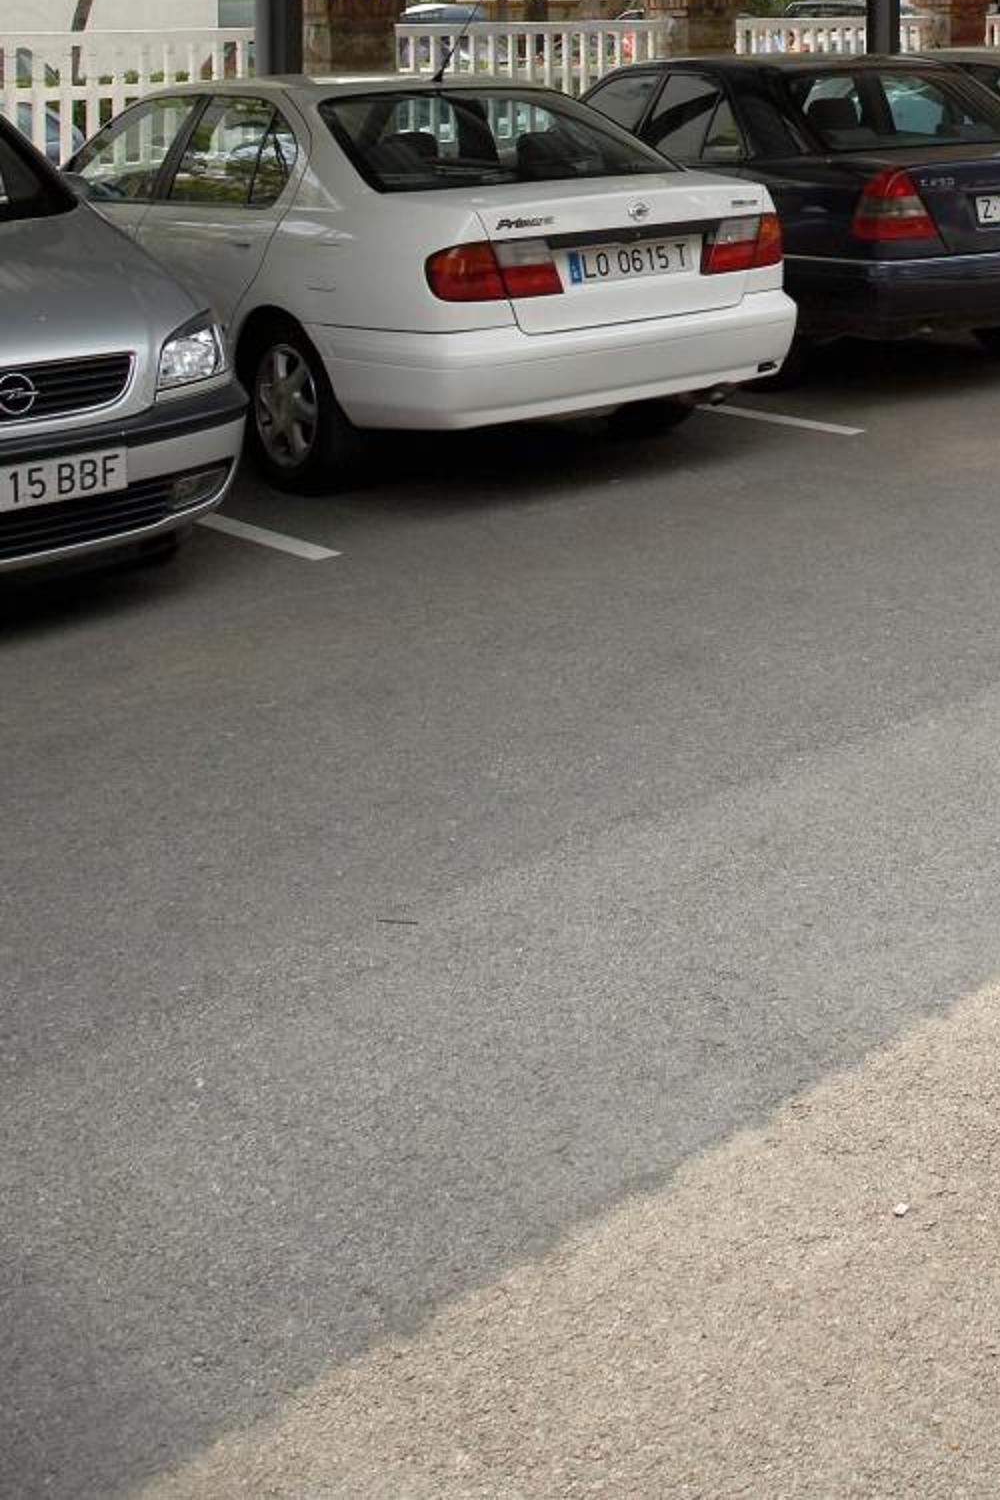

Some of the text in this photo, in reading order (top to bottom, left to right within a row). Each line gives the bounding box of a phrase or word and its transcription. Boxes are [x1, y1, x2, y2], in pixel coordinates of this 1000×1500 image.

[618, 245, 669, 274] 0615
[674, 243, 687, 267] T
[57, 453, 120, 495] BBF
